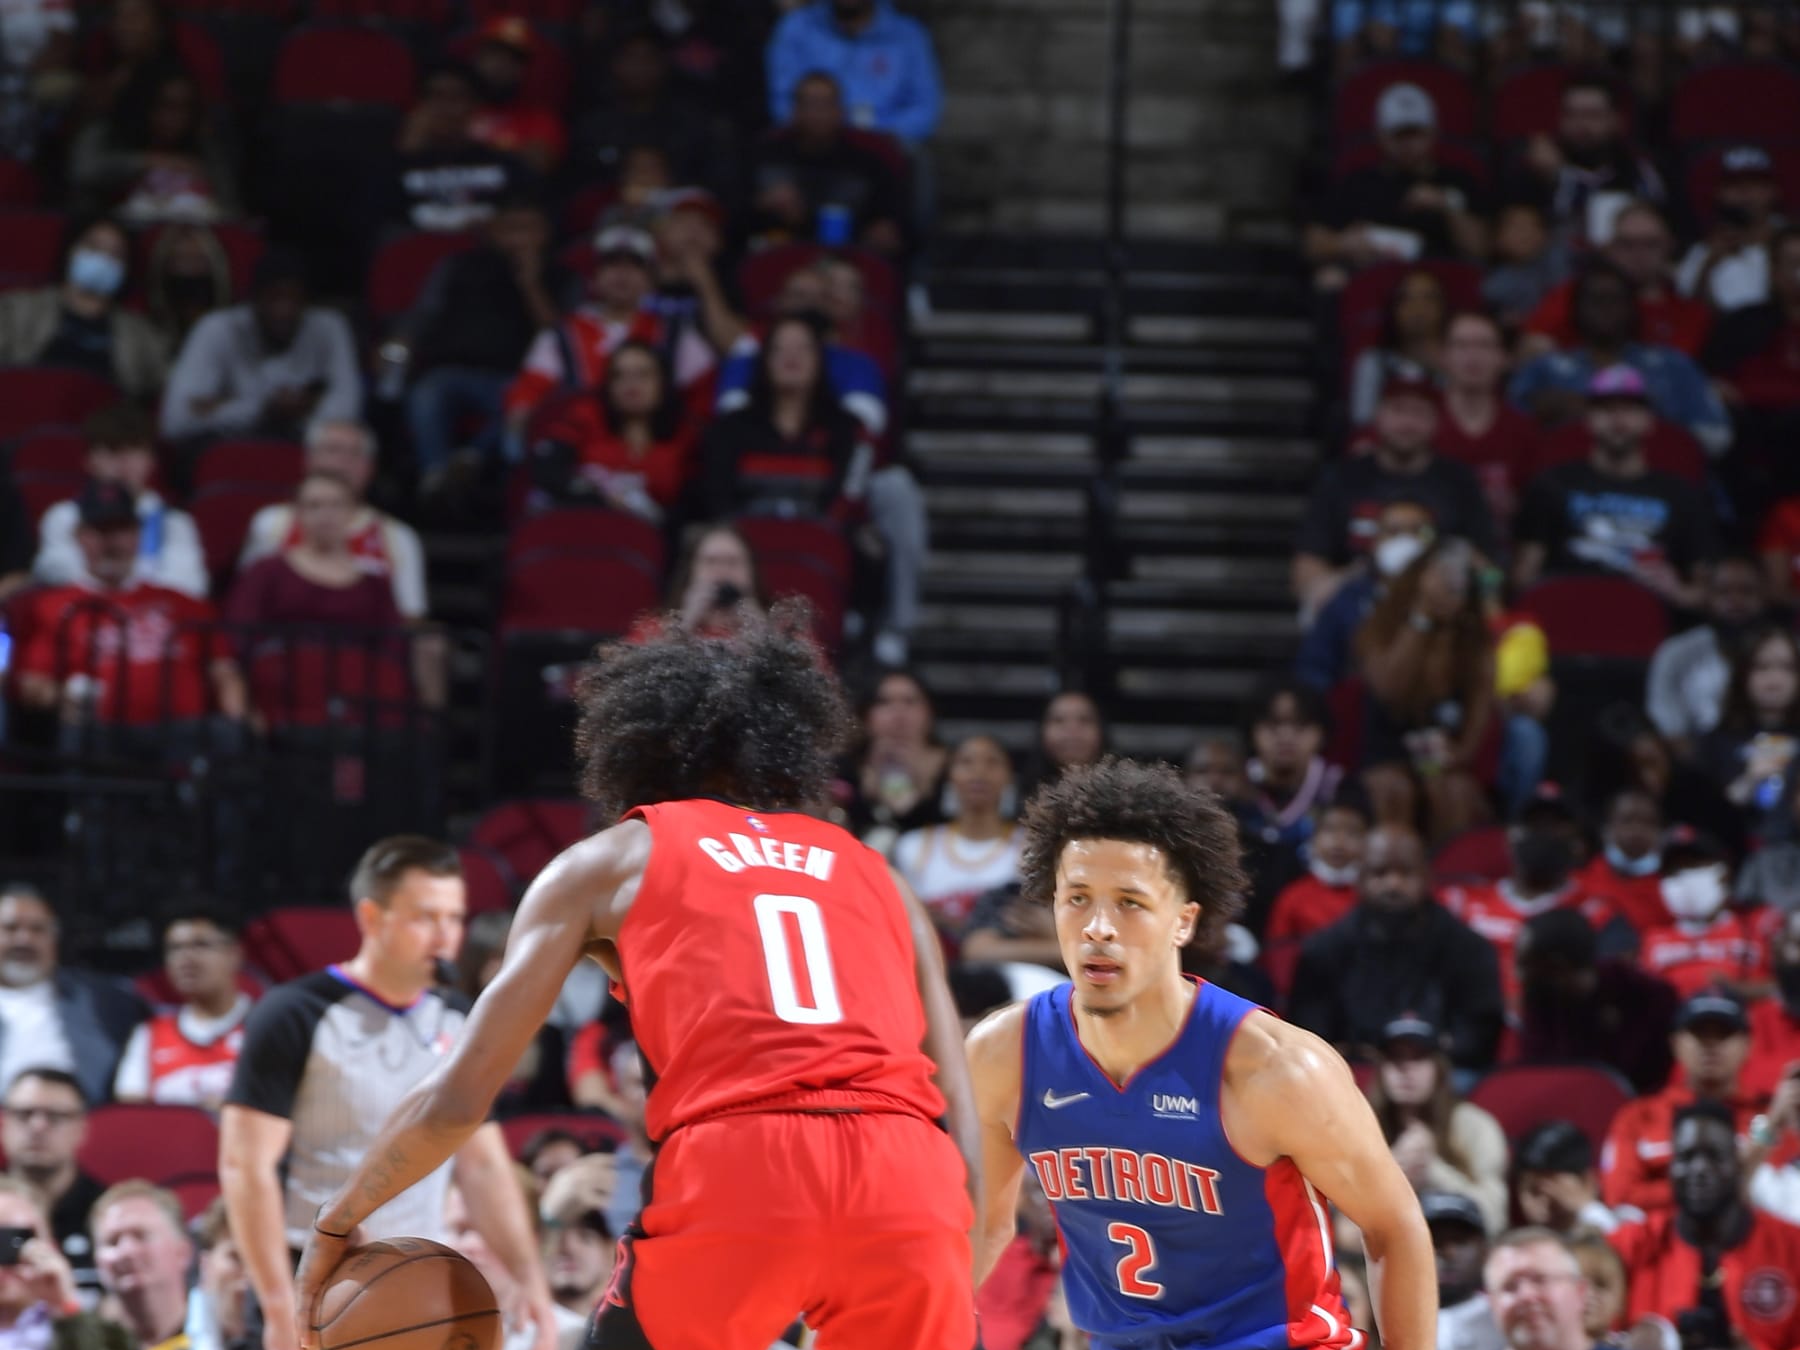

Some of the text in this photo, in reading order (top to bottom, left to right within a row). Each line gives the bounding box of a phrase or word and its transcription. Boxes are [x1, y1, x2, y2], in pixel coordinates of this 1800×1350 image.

[699, 832, 834, 881] GREEN
[753, 893, 842, 1024] 0
[1152, 1094, 1199, 1114] UWM
[1029, 1147, 1223, 1215] DETROIT
[1108, 1222, 1164, 1298] 2
